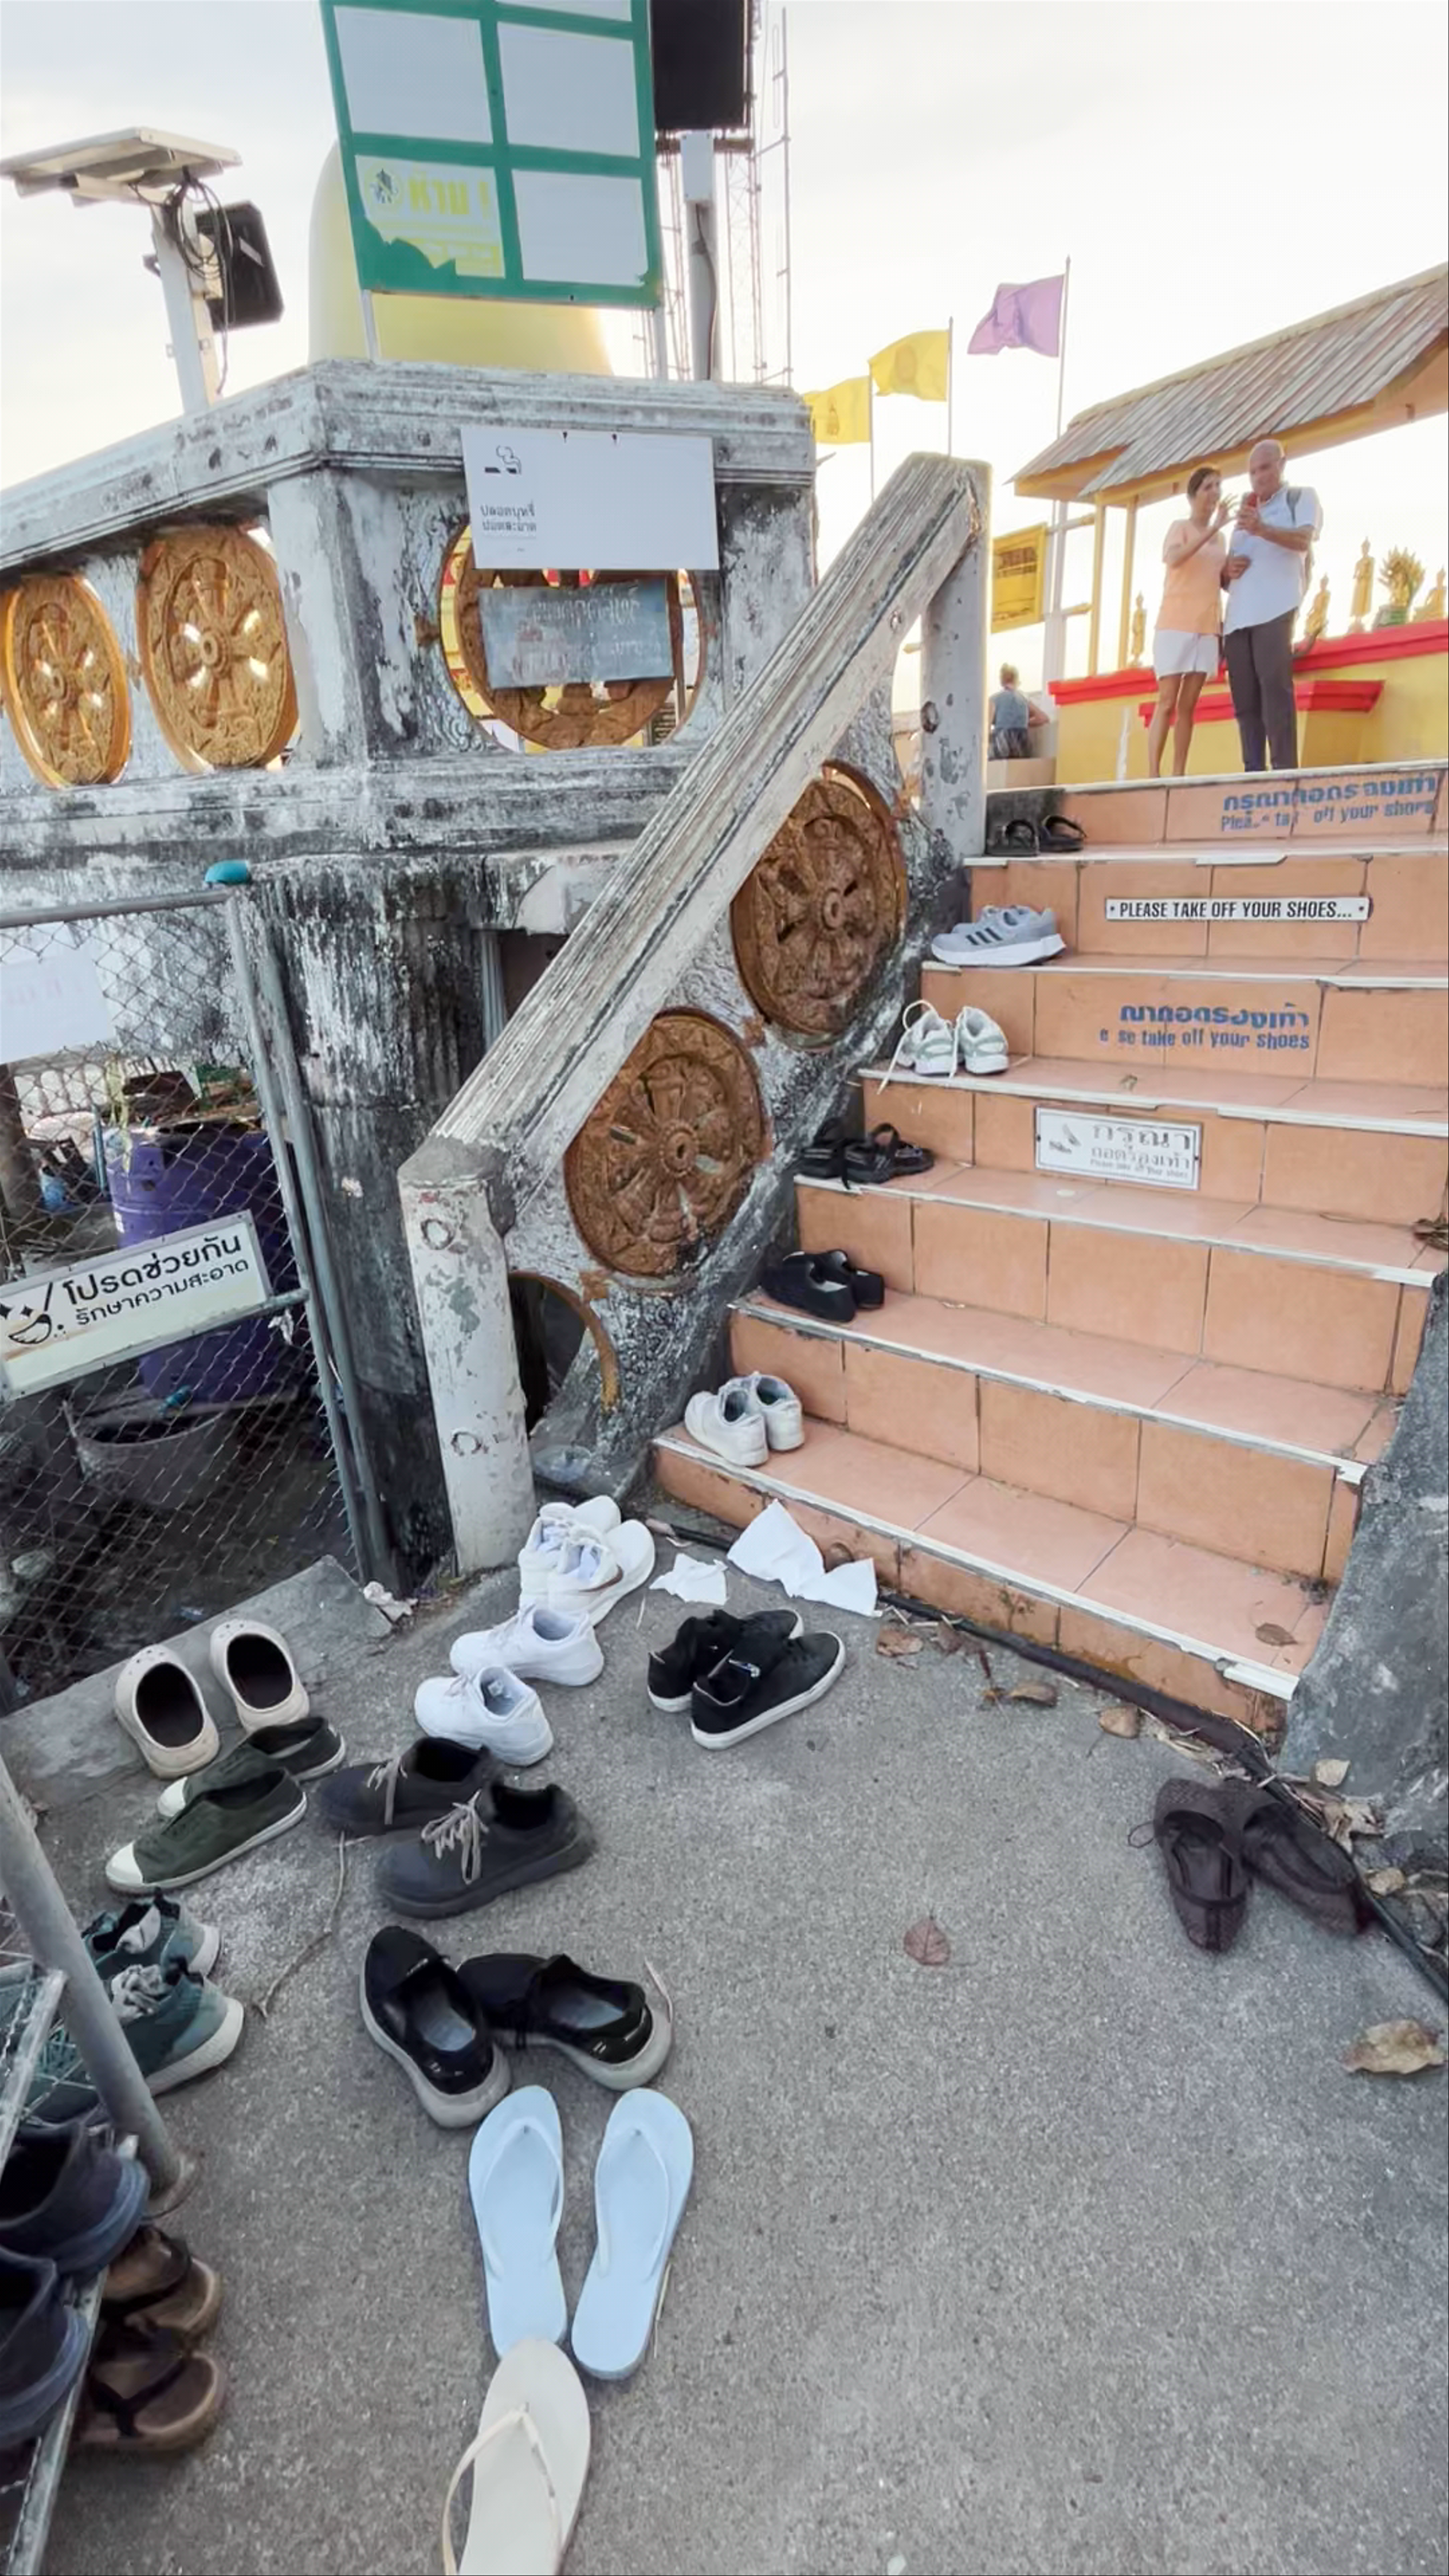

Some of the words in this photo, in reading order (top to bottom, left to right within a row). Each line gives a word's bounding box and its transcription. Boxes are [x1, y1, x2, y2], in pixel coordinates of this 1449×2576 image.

[1341, 804, 1378, 823] your
[1119, 901, 1167, 918] PLEASE
[1172, 901, 1207, 917] TAKE
[1212, 901, 1237, 917] OFF
[1242, 901, 1281, 917] YOUR
[1287, 901, 1352, 917] SHOES...
[1210, 1031, 1250, 1048] your
[1257, 1032, 1309, 1049] shoes
[1093, 1126, 1190, 1149] กรุณา
[63, 1235, 242, 1306] โปรดช่วยกัน
[75, 1259, 249, 1326] รักษาความสะอาด
